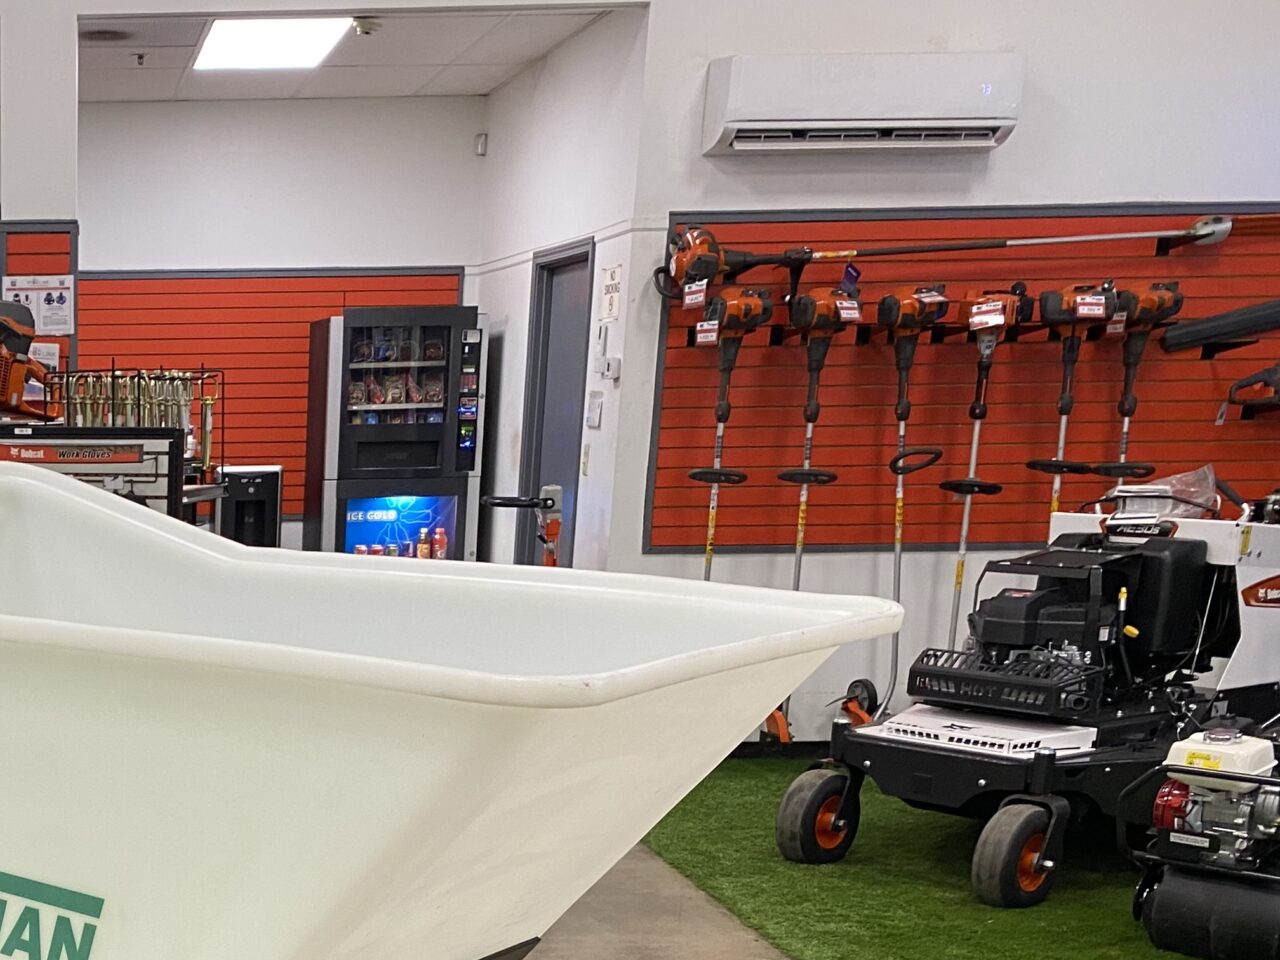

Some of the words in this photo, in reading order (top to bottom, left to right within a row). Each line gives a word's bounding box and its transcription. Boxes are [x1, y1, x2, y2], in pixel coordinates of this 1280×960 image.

[57, 450, 80, 460] Work
[82, 449, 112, 460] Gloves
[347, 511, 365, 522] ICE
[959, 681, 997, 698] HOT
